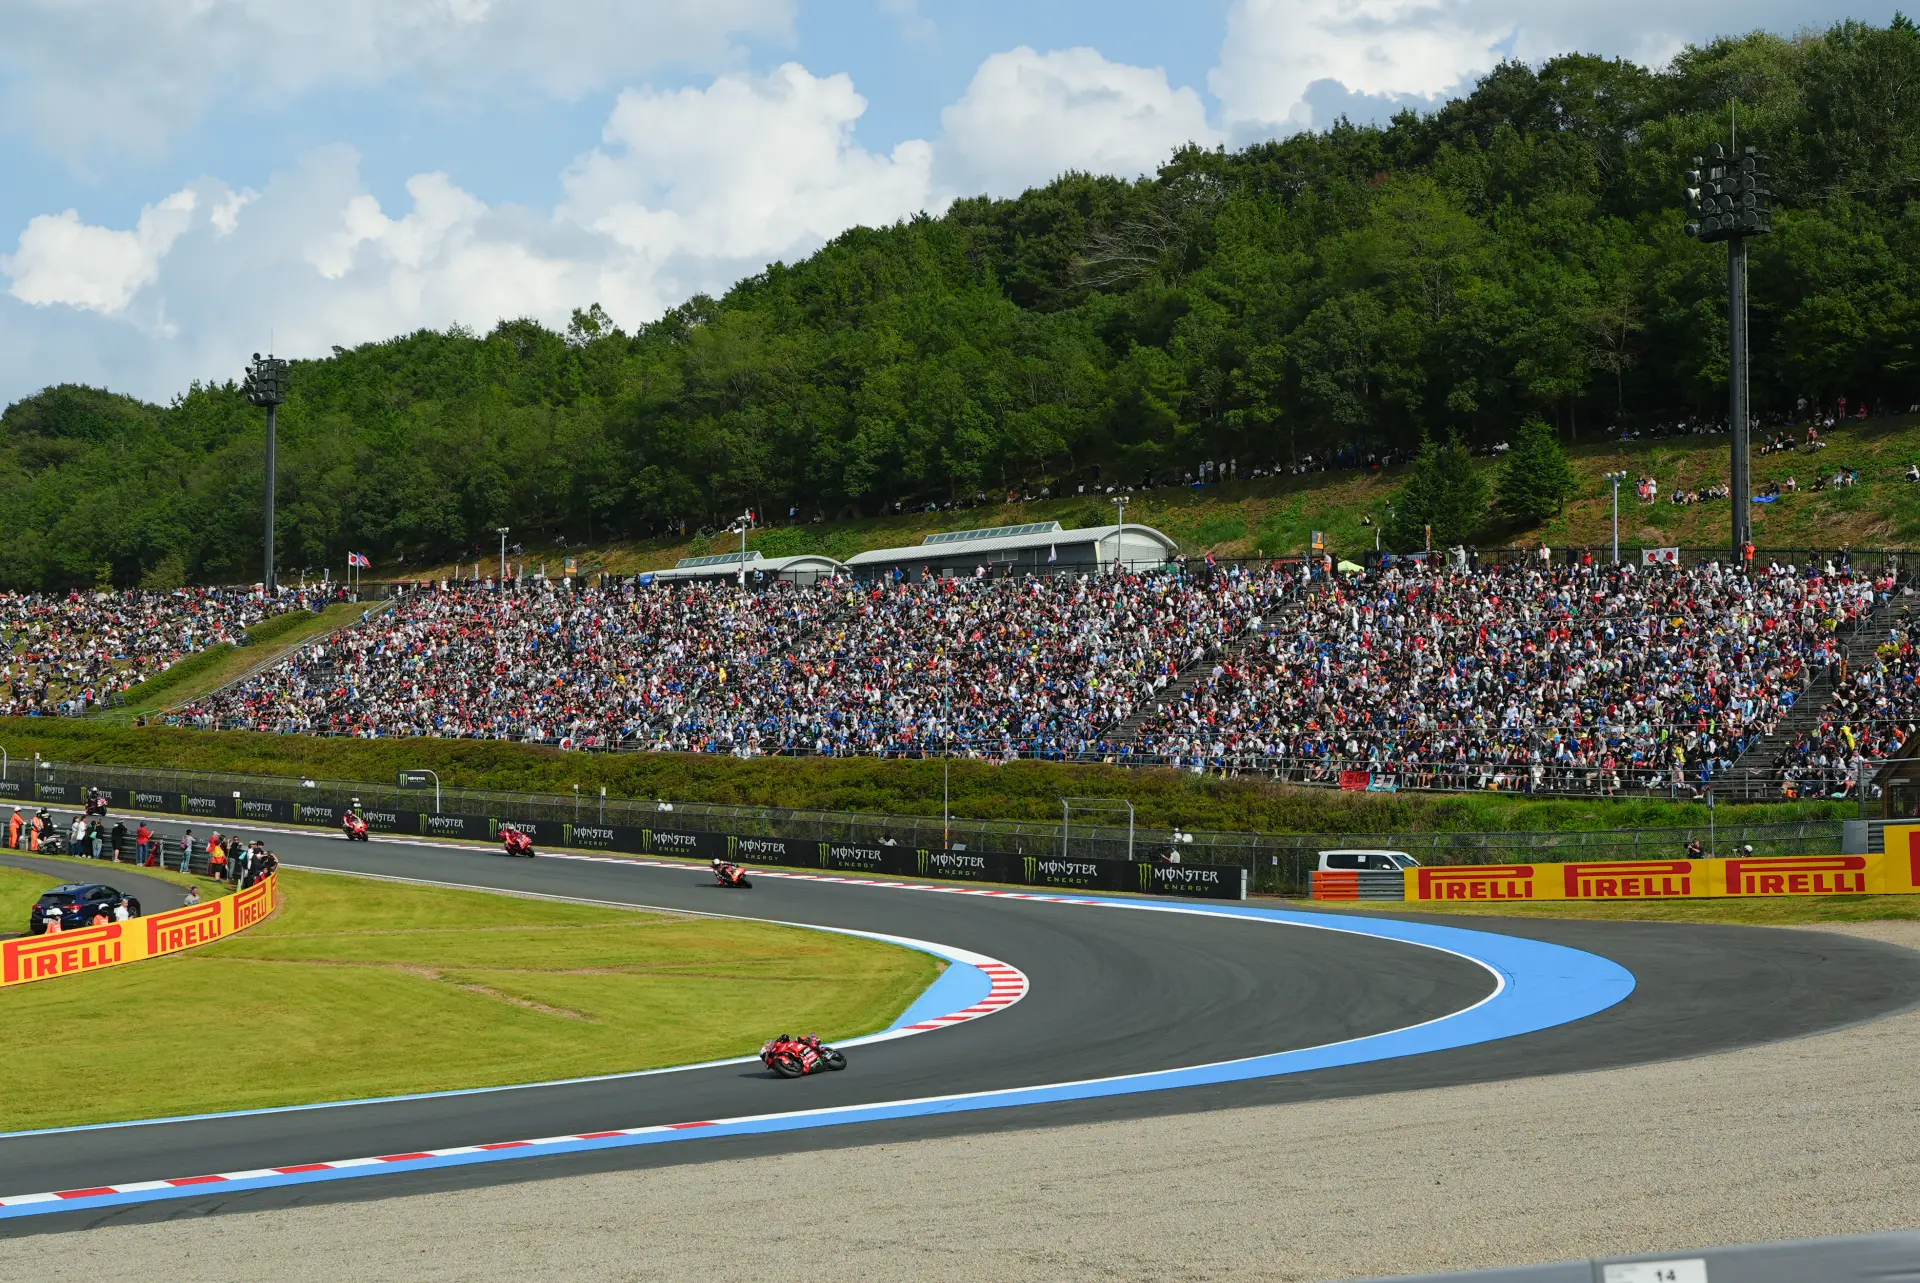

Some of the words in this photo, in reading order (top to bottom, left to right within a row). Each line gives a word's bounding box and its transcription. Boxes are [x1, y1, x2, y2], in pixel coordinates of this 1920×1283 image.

[136, 793, 163, 803] MONSTER
[188, 797, 217, 808] MONSTER
[243, 801, 273, 812] MONSTER
[301, 806, 333, 817] MONSTER
[363, 811, 396, 823] MONSTER
[428, 816, 464, 828] MONSTER
[573, 826, 614, 840] MONSTER
[653, 832, 697, 846] MONSTER
[739, 839, 786, 854] MONSTER
[831, 844, 882, 861] MONSTER
[839, 861, 874, 869] ENERGY
[930, 852, 985, 869] MONSTER
[1038, 858, 1098, 876] MONSTER
[1047, 876, 1089, 884] ENERGY
[1154, 866, 1219, 884] MONSTER
[1564, 861, 1692, 897] PIRELLI
[1725, 856, 1866, 894] PIRELLI
[1164, 884, 1209, 892] ENERGY
[1418, 866, 1534, 900] PIRELLI
[234, 882, 267, 930] PIRELLI
[147, 901, 222, 955] PIRELLI
[3, 924, 122, 982] PIRELLI
[1656, 1269, 1676, 1281] 14
